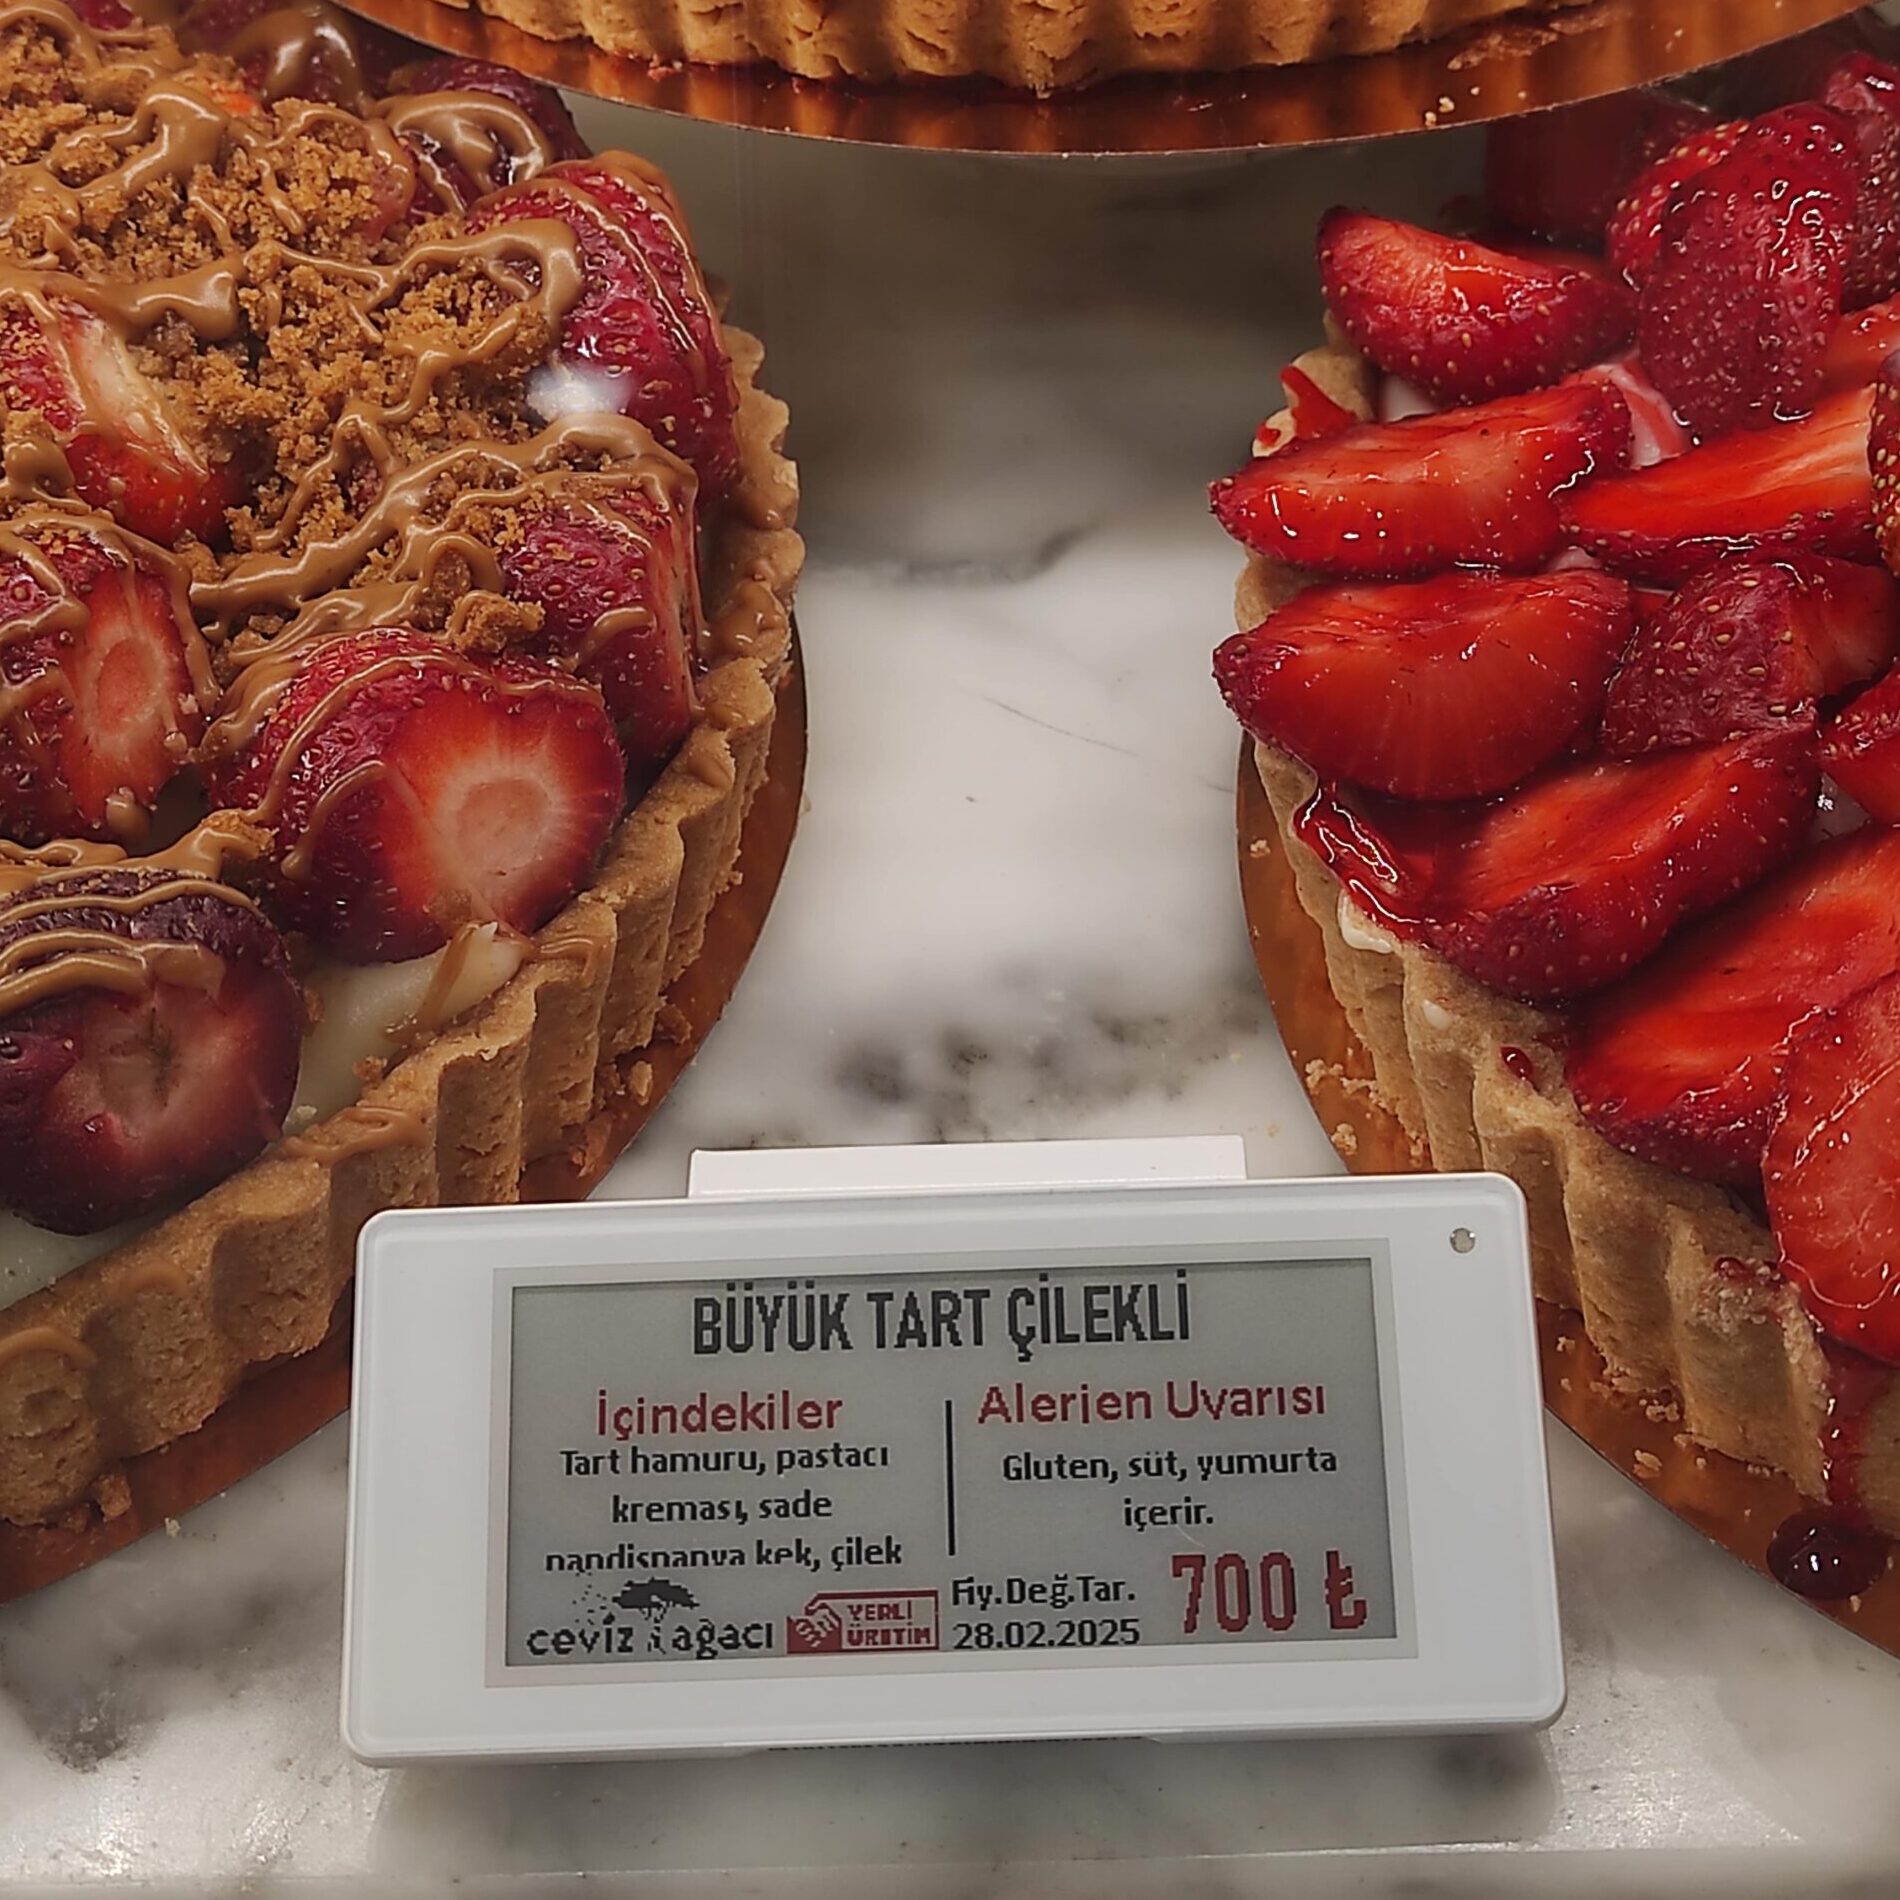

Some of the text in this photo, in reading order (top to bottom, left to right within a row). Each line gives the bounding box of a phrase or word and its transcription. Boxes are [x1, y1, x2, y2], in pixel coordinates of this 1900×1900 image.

[693, 1269, 1190, 1361] BÜYÜK TART ÇİLEKLİ
[598, 1390, 843, 1440] İçindekiler
[561, 1443, 888, 1476] Tart hamuru, pastacı
[1003, 1447, 1337, 1483] Gluten, süt, yumurta
[759, 1490, 832, 1518] sade
[1124, 1497, 1214, 1532] içerir.
[756, 1539, 820, 1572] kek,
[831, 1536, 902, 1571] çilek
[952, 1573, 1136, 1609] Fiy.Değ.Tar.
[1171, 1551, 1298, 1634] 700
[527, 1615, 773, 1660] ceviz ağacı
[953, 1618, 1140, 1650] 28.02.2025
